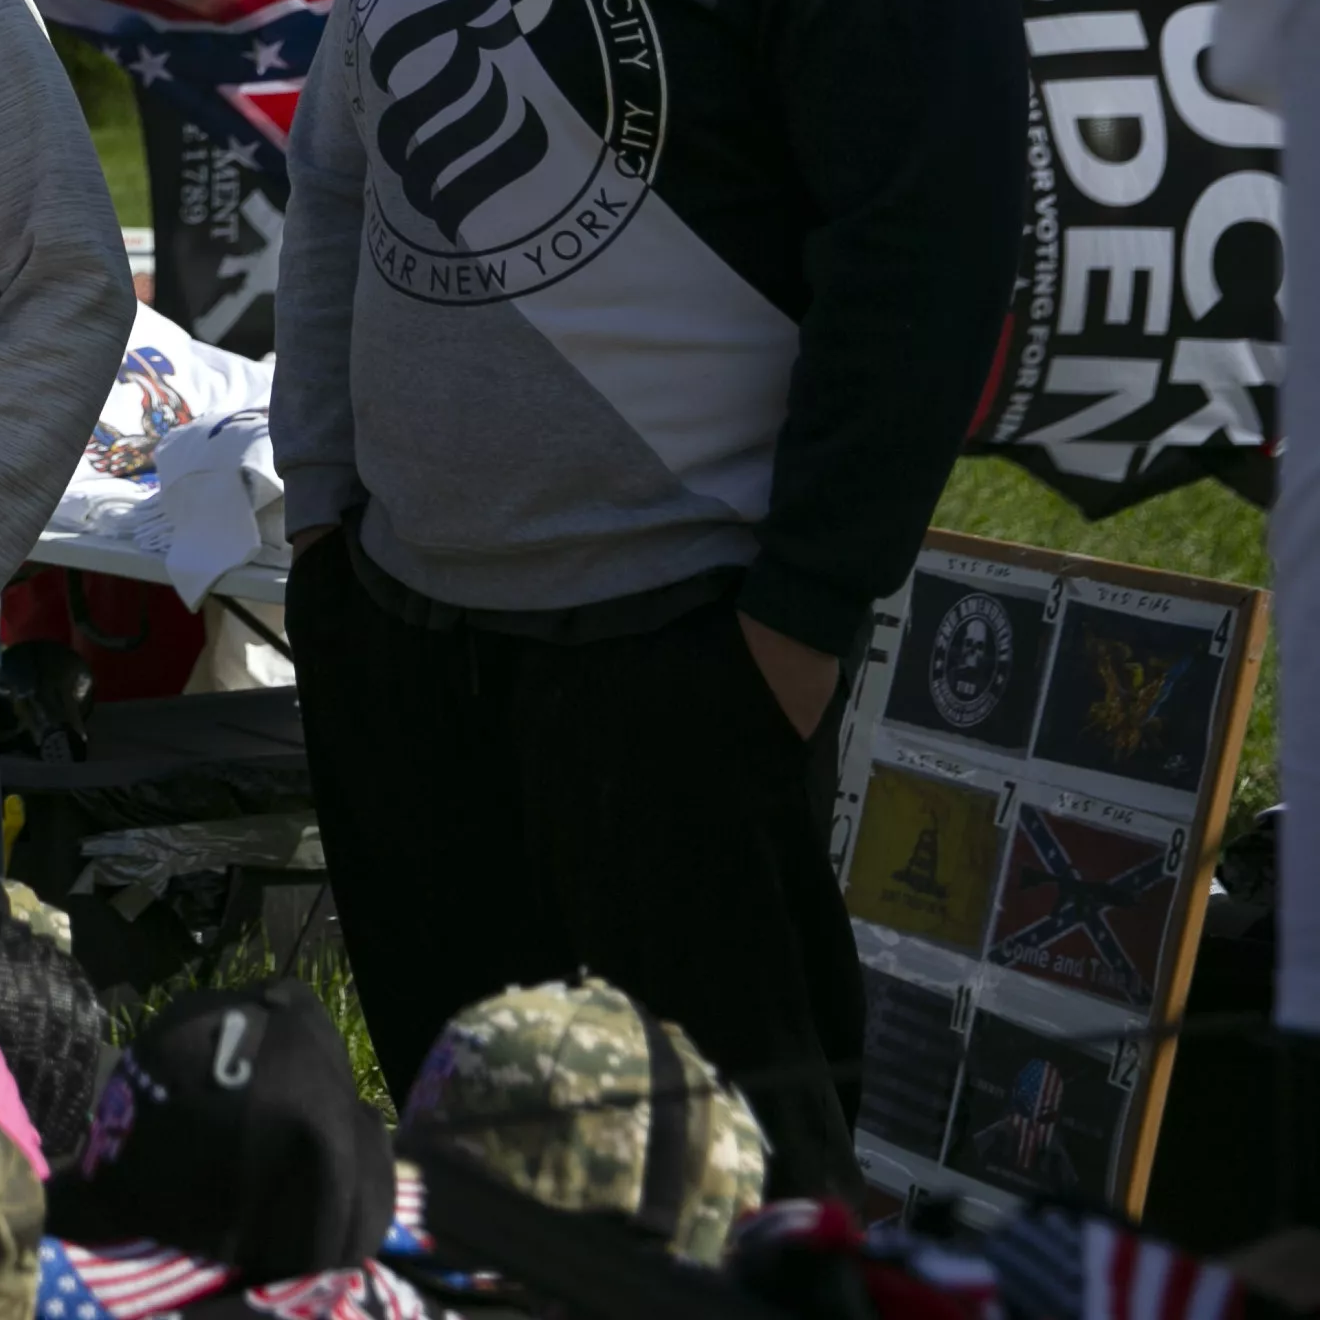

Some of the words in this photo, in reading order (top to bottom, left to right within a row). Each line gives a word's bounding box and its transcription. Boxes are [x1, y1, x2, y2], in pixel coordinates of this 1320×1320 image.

[1027, 128, 1056, 194] FOR
[430, 259, 507, 296] NEW
[522, 186, 628, 278] YORK
[613, 99, 655, 180] CITY
[1030, 193, 1059, 321] VOTING
[1015, 323, 1050, 389] FOR
[1046, 574, 1064, 621] 3
[1213, 609, 1233, 654] 4
[998, 780, 1017, 824] 7
[1167, 827, 1186, 873] 8
[1000, 935, 1051, 972] Come
[1052, 952, 1086, 979] and
[954, 983, 973, 1030] 11
[1110, 1036, 1140, 1089] 12
